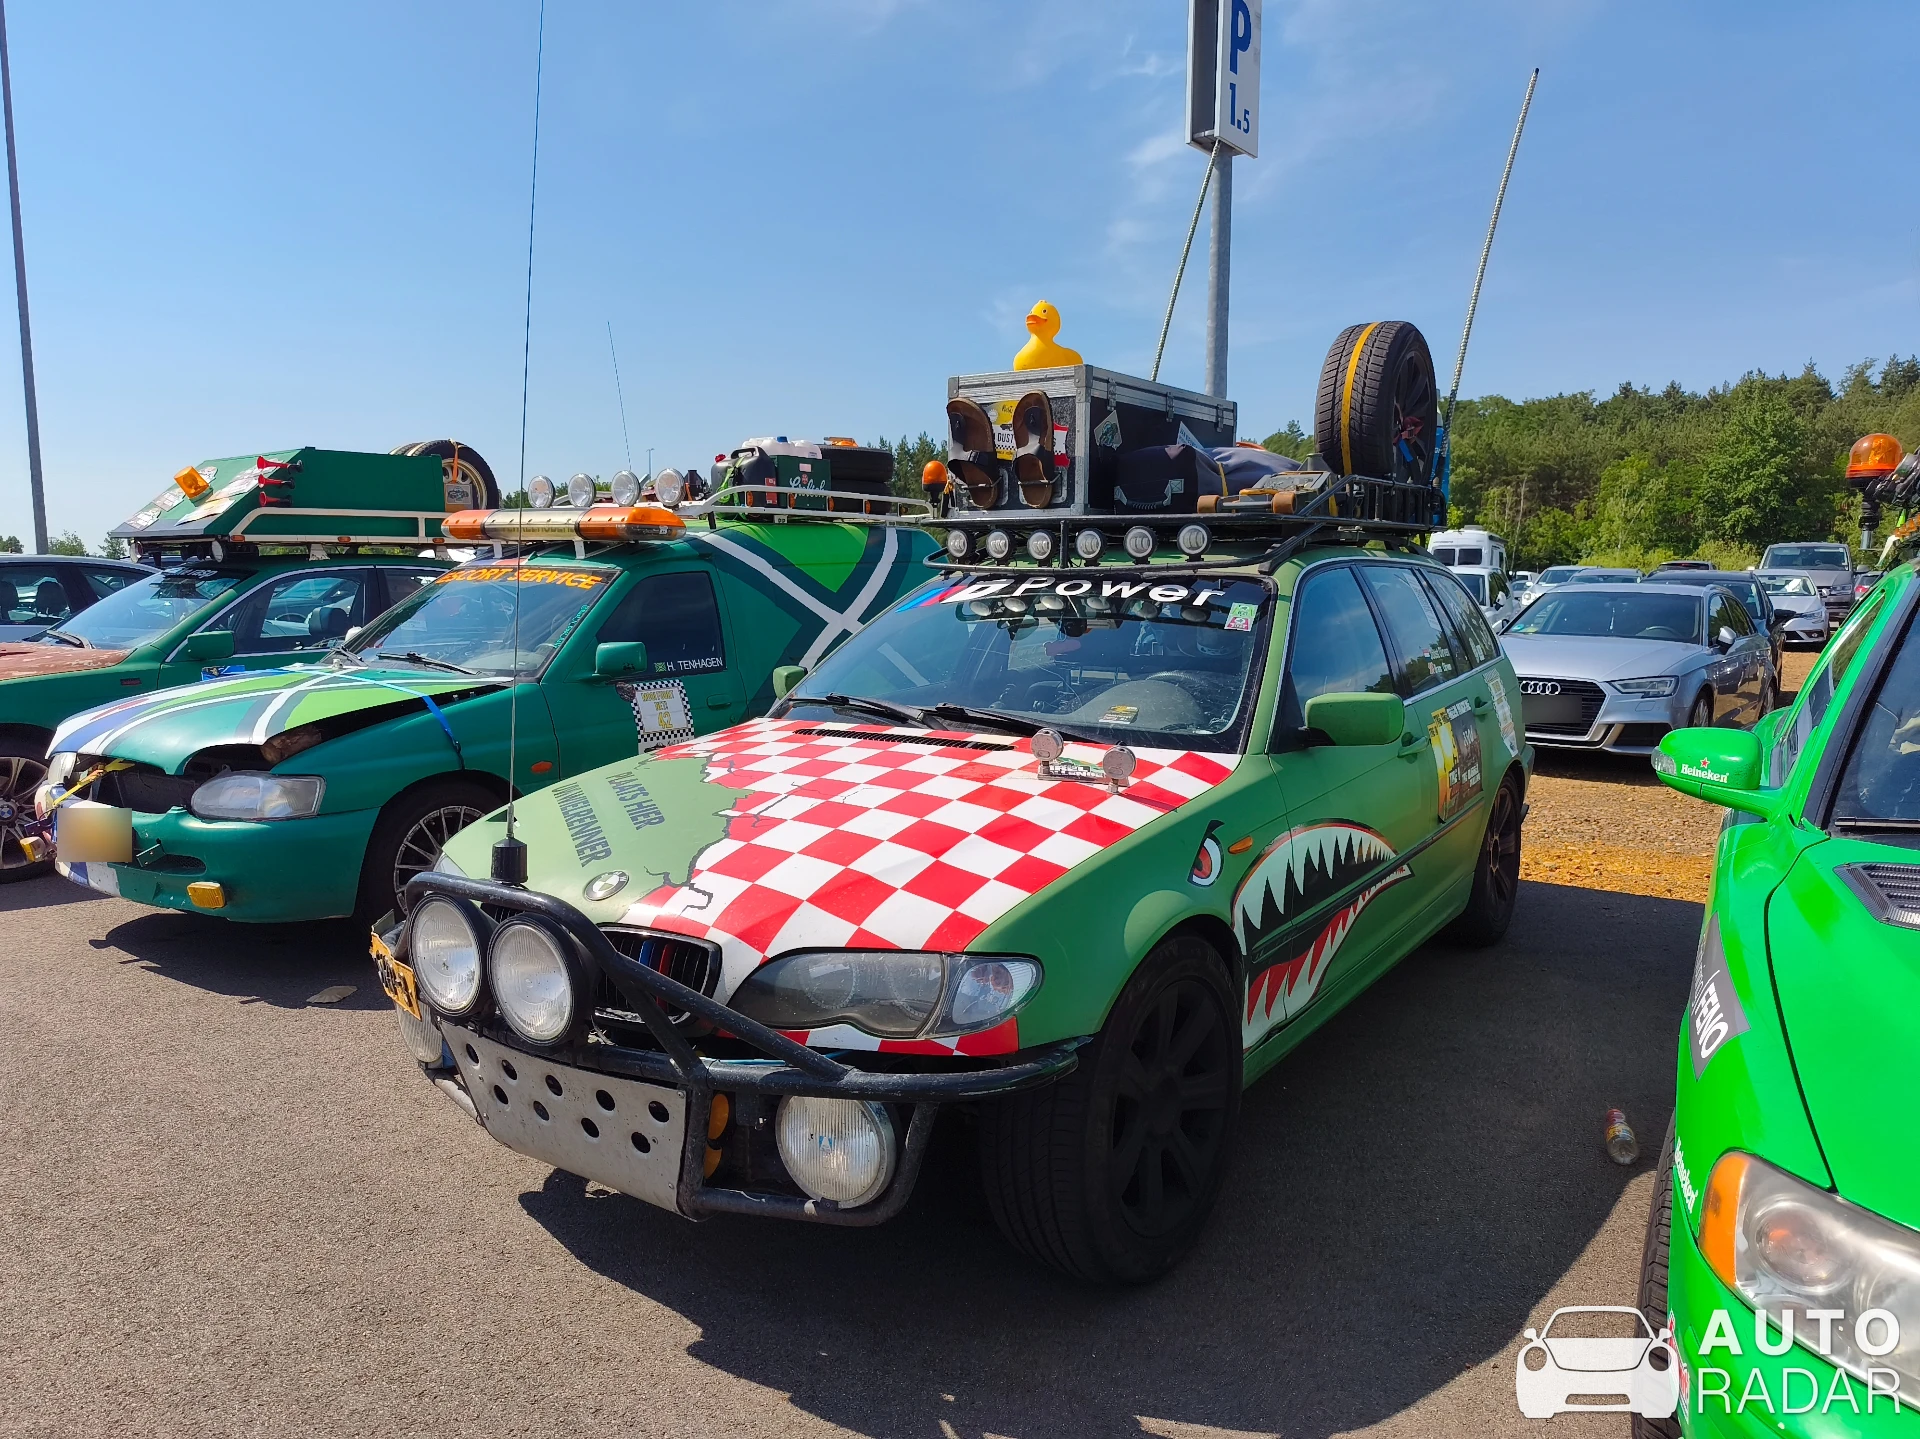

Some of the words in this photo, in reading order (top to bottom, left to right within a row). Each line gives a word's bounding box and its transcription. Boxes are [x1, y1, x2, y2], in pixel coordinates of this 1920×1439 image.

[1230, 0, 1251, 75] P
[997, 432, 1014, 443] DUST
[436, 568, 513, 585] ESCORT
[507, 568, 603, 590] SERVICE
[1012, 577, 1226, 606] Power
[666, 661, 677, 672] H.
[677, 657, 723, 671] TENHAGEN
[658, 711, 673, 729] 42
[1681, 763, 1728, 783] Heineken
[605, 771, 649, 802] PLAATS
[623, 798, 666, 831] HIER
